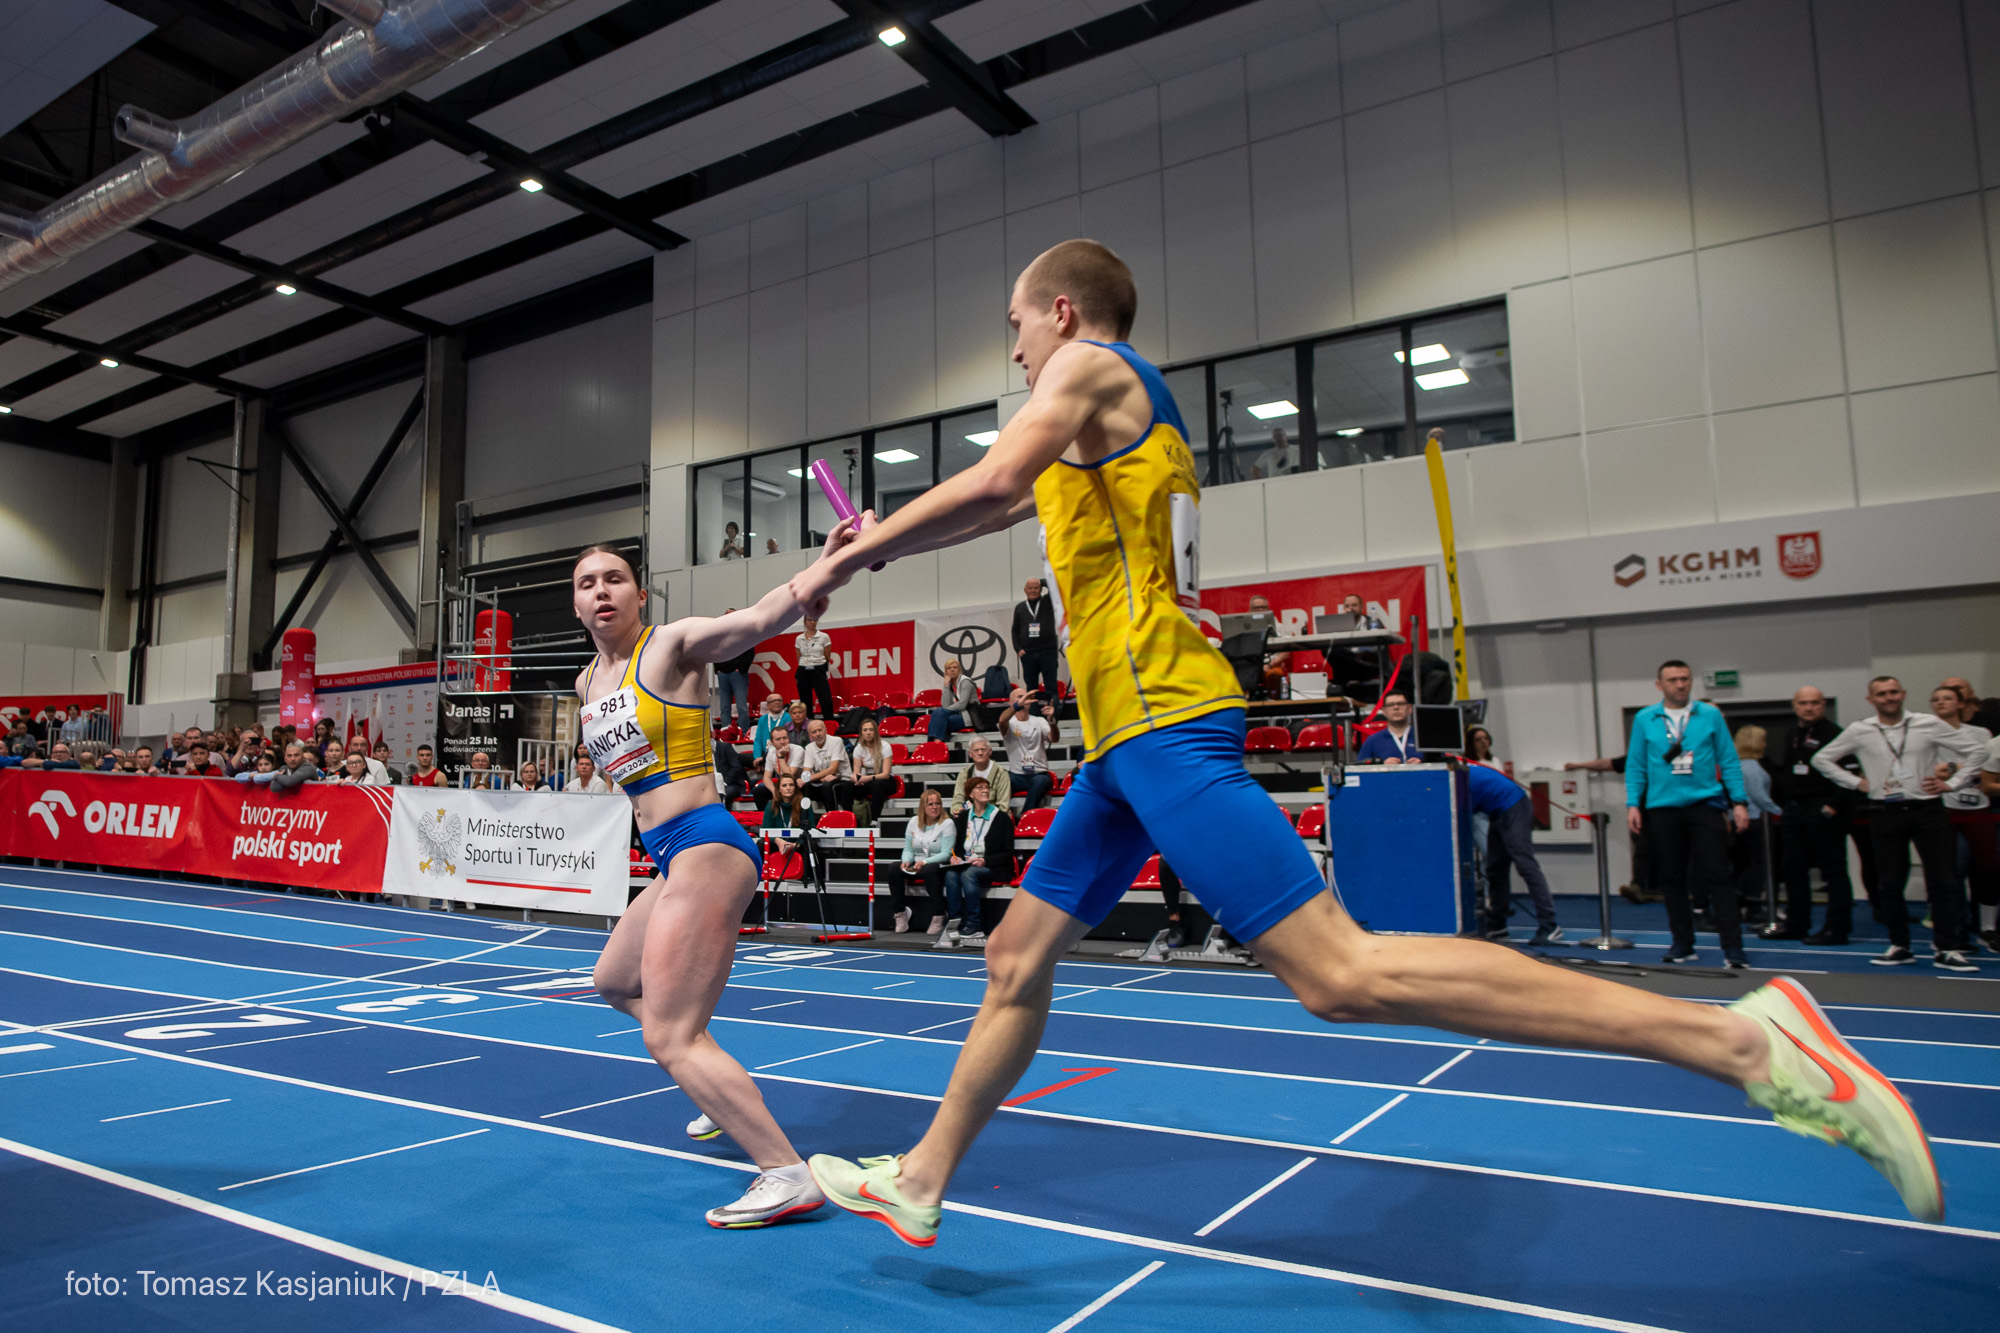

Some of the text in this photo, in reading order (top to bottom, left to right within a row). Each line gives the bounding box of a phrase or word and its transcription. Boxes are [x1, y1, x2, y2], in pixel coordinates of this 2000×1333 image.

[1658, 546, 1760, 575] KGHM
[828, 646, 901, 680] RLEN
[446, 703, 491, 717] Janas
[600, 693, 627, 718] 981
[443, 745, 497, 753] doświadczenia
[469, 736, 481, 745] 25
[484, 736, 498, 745] lat
[627, 757, 649, 771] 2024
[84, 800, 181, 839] ORLEN
[240, 800, 328, 836] tworzymy
[467, 817, 565, 841] Ministerstwo
[231, 830, 342, 867] polski sport
[464, 843, 595, 873] Sportu i Turystyki
